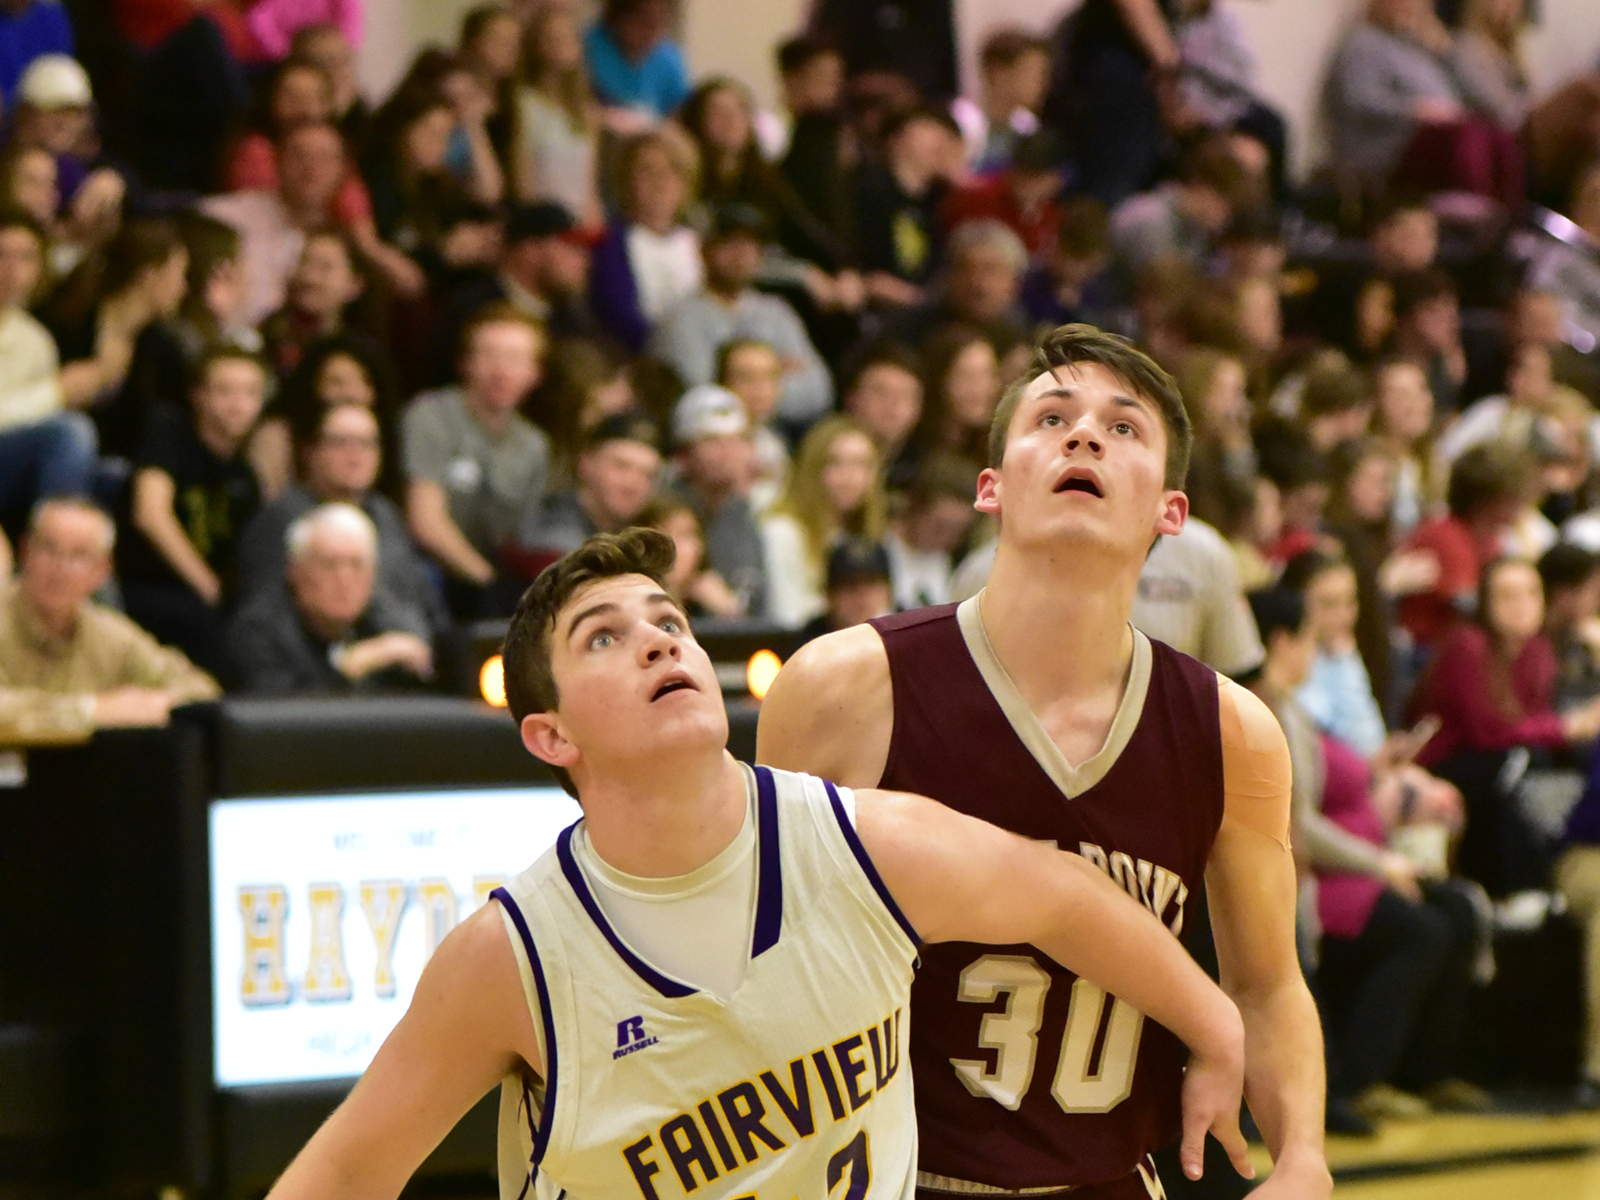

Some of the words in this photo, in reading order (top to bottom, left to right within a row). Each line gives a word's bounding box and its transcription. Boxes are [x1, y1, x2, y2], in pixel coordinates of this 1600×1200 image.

[237, 874, 512, 1009] HAYD
[612, 1035, 660, 1060] RUSSELL
[950, 953, 1146, 1114] 30
